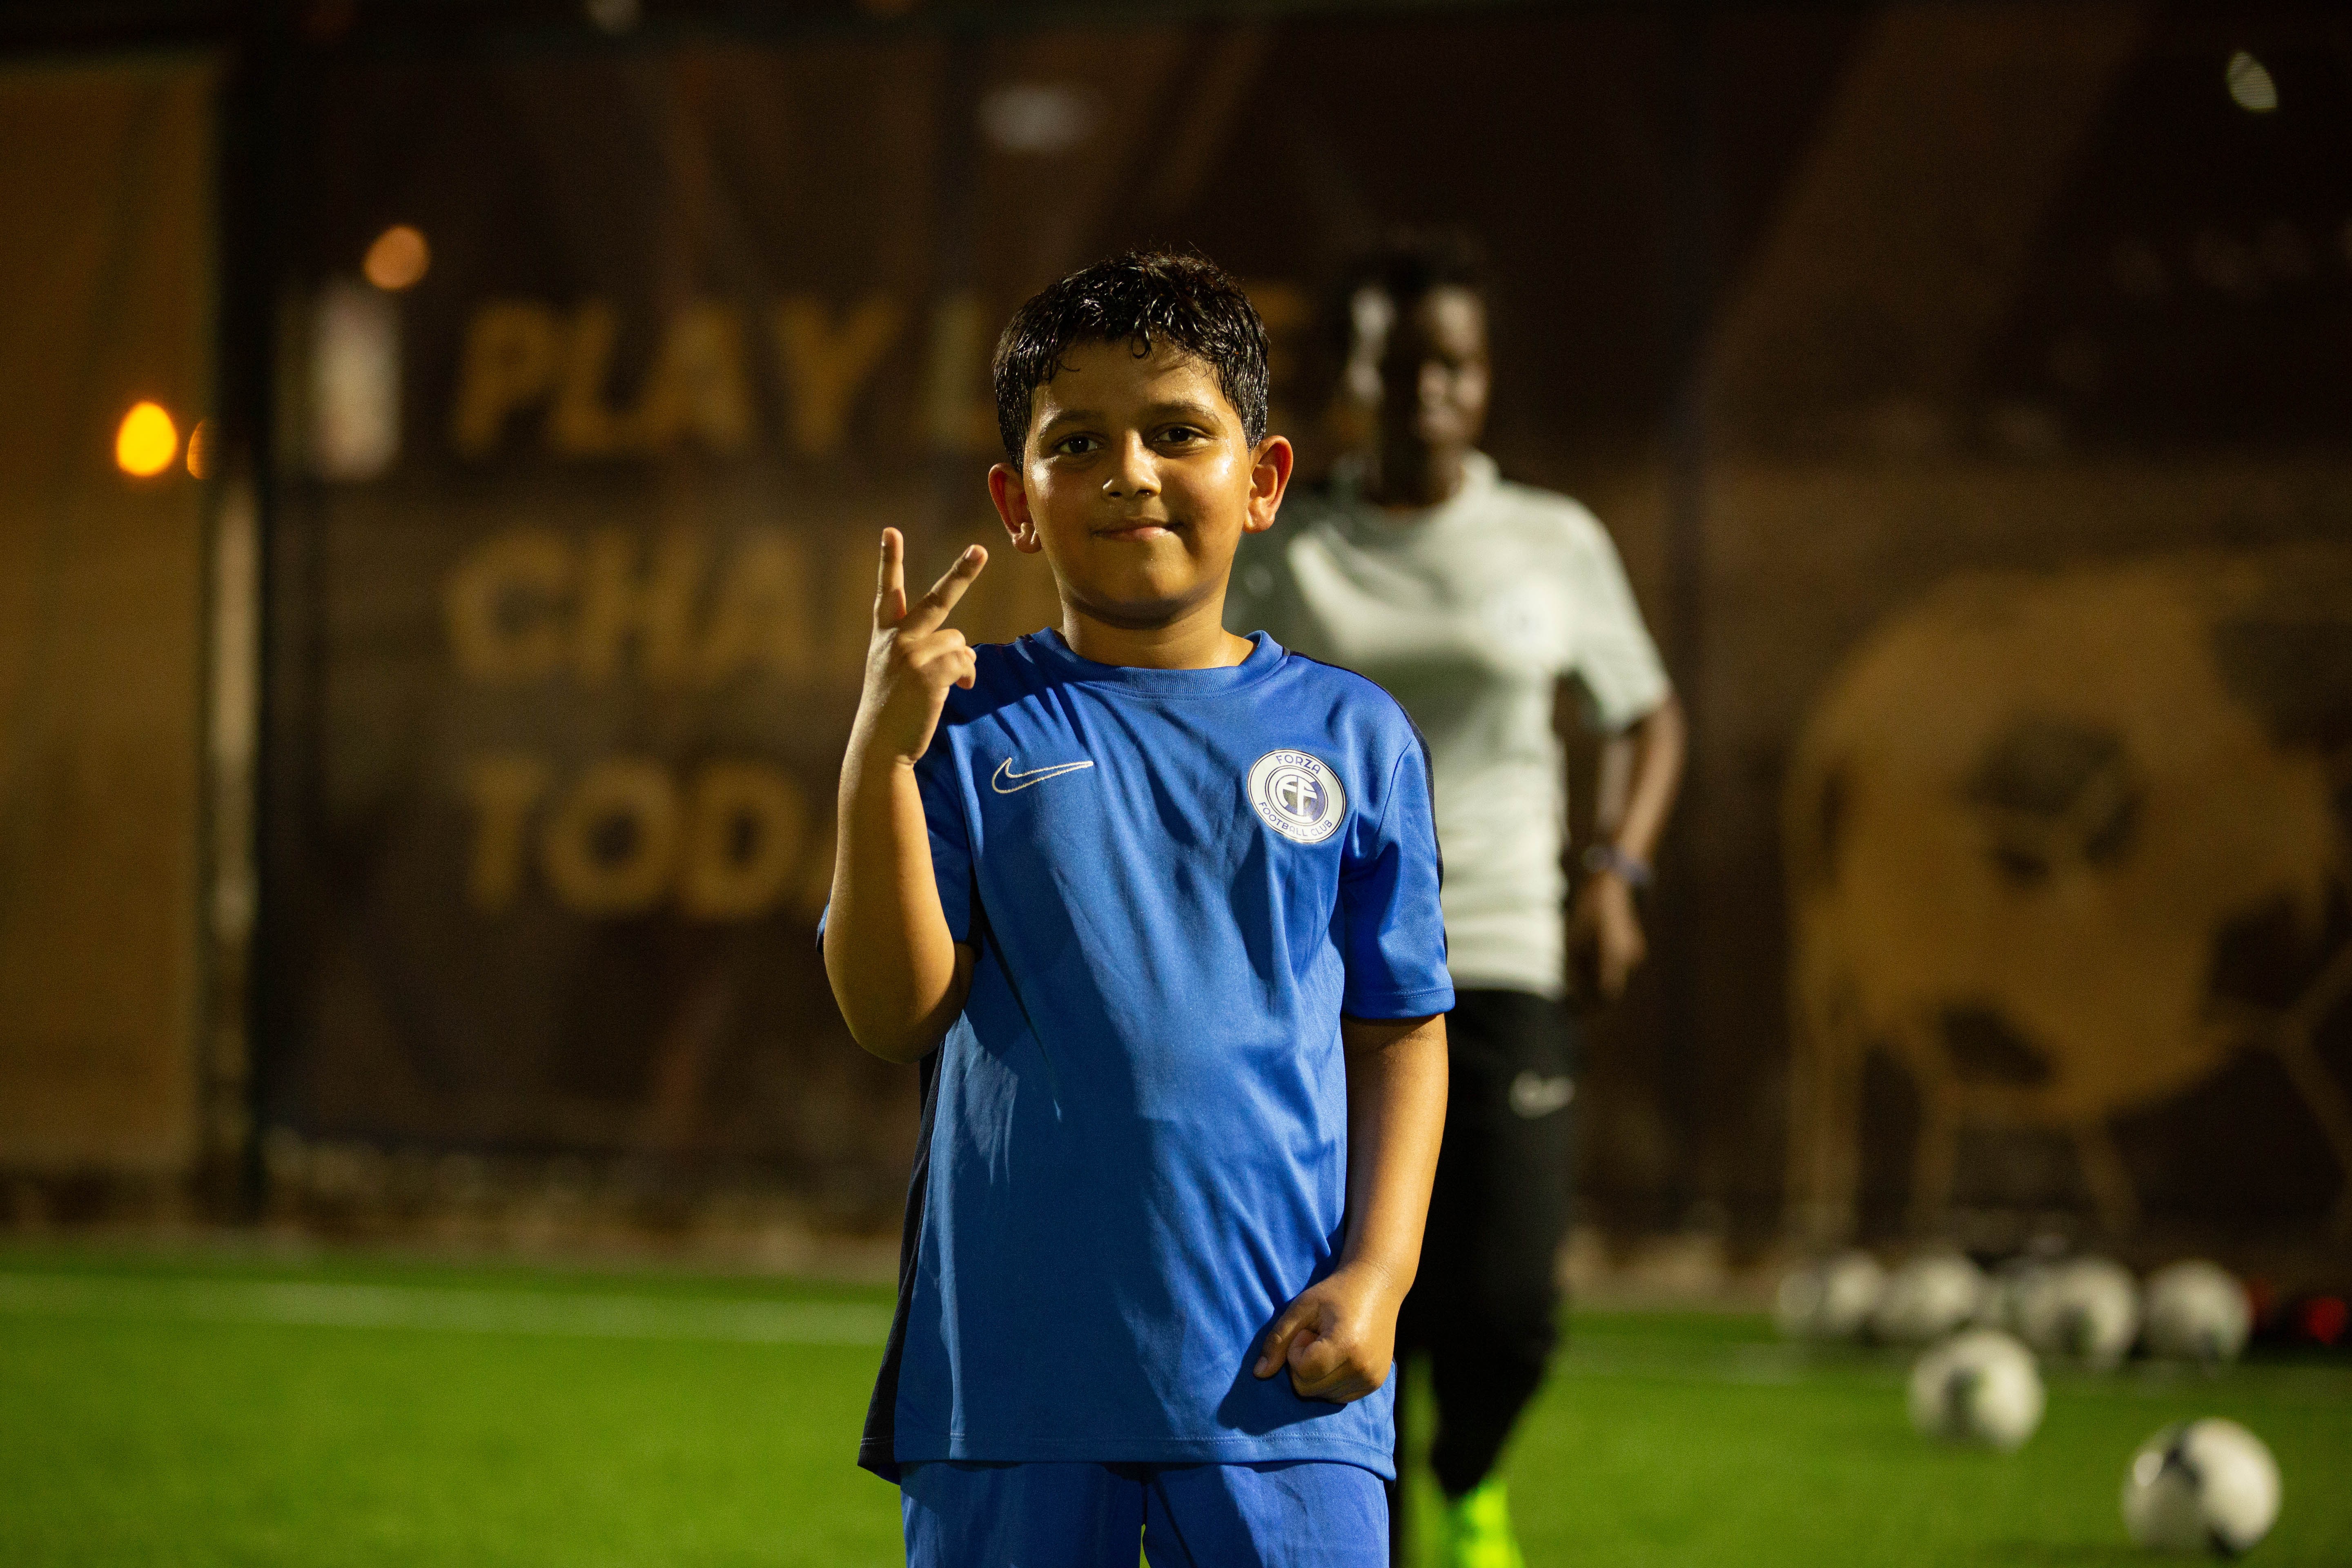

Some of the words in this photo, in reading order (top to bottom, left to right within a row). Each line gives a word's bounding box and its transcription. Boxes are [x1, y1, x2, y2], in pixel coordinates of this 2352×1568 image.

[453, 297, 900, 453] PLAY
[1276, 754, 1321, 774] FORZA
[1258, 802, 1308, 837] FOOTBALL
[1310, 820, 1333, 836] CLUB
